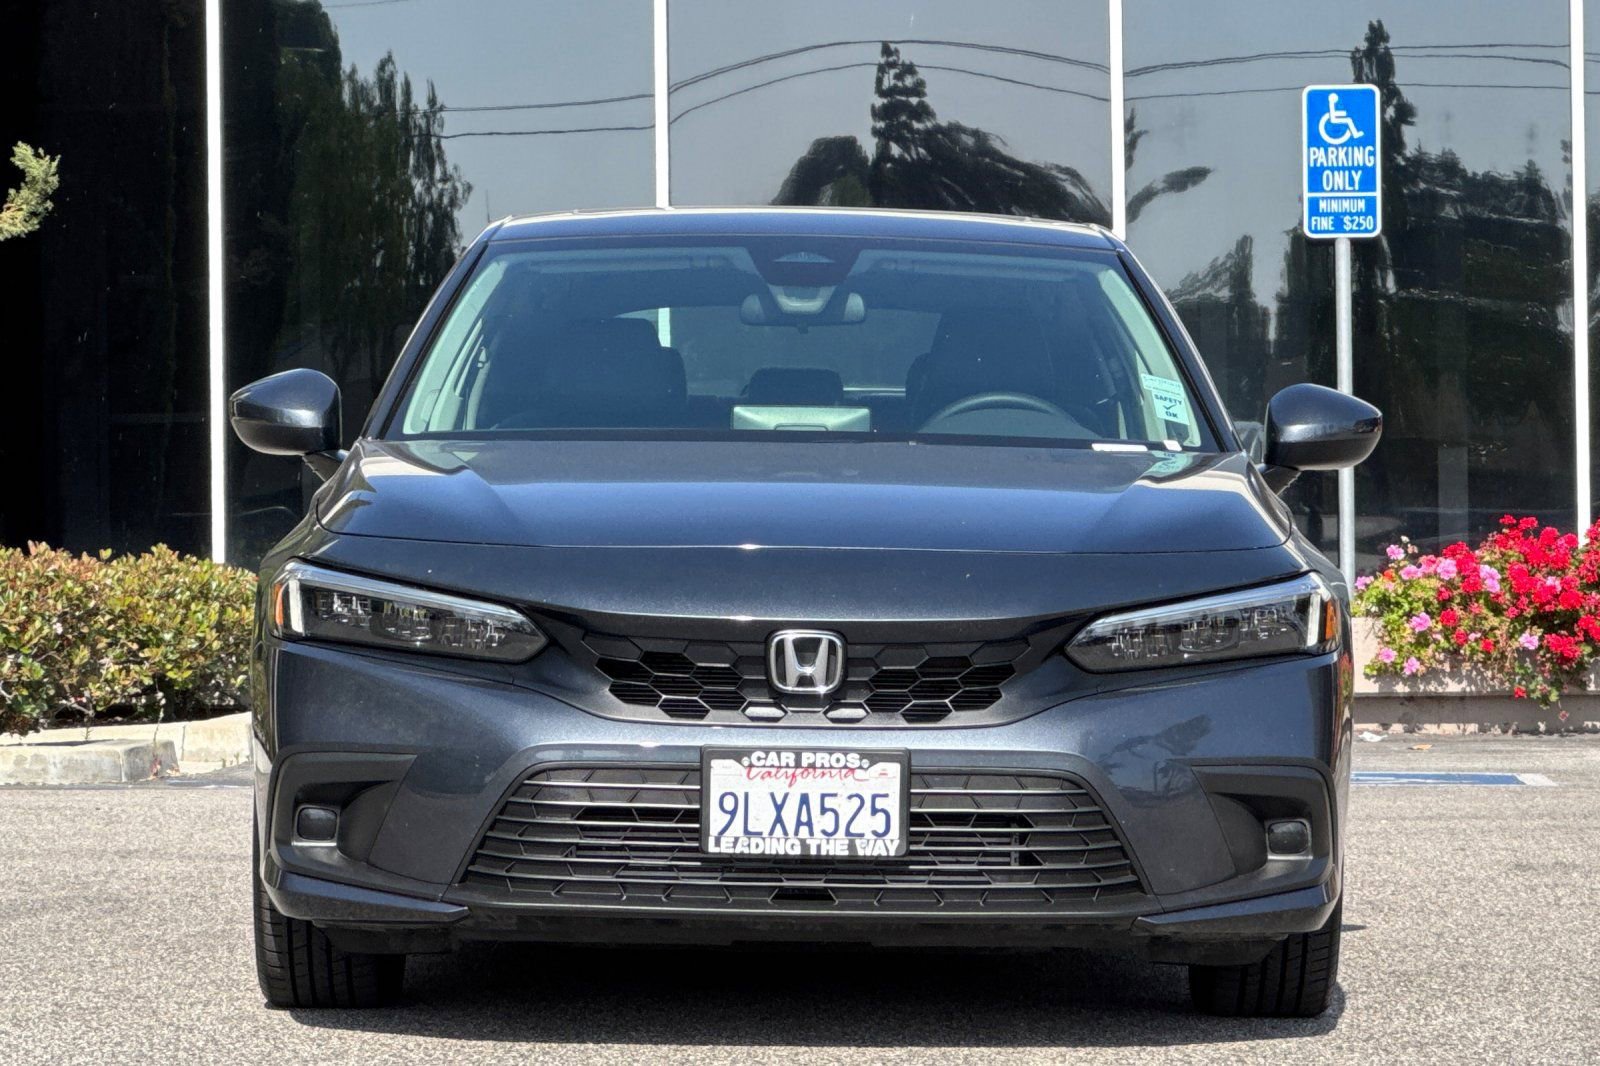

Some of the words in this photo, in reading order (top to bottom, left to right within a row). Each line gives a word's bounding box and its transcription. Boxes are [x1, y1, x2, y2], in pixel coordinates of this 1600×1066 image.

[1309, 146, 1375, 167] PARKING
[1322, 170, 1362, 191] ONLY
[1319, 198, 1366, 213] MINIMUM
[1311, 216, 1335, 230] FINE
[1343, 216, 1374, 231] $250
[1154, 394, 1182, 405] SAFETY
[750, 751, 796, 767] CAR
[801, 752, 861, 768] PROS
[718, 792, 891, 837] 9LXA525
[708, 836, 801, 855] LEADING
[806, 838, 850, 855] THE
[855, 838, 899, 856] WAY
